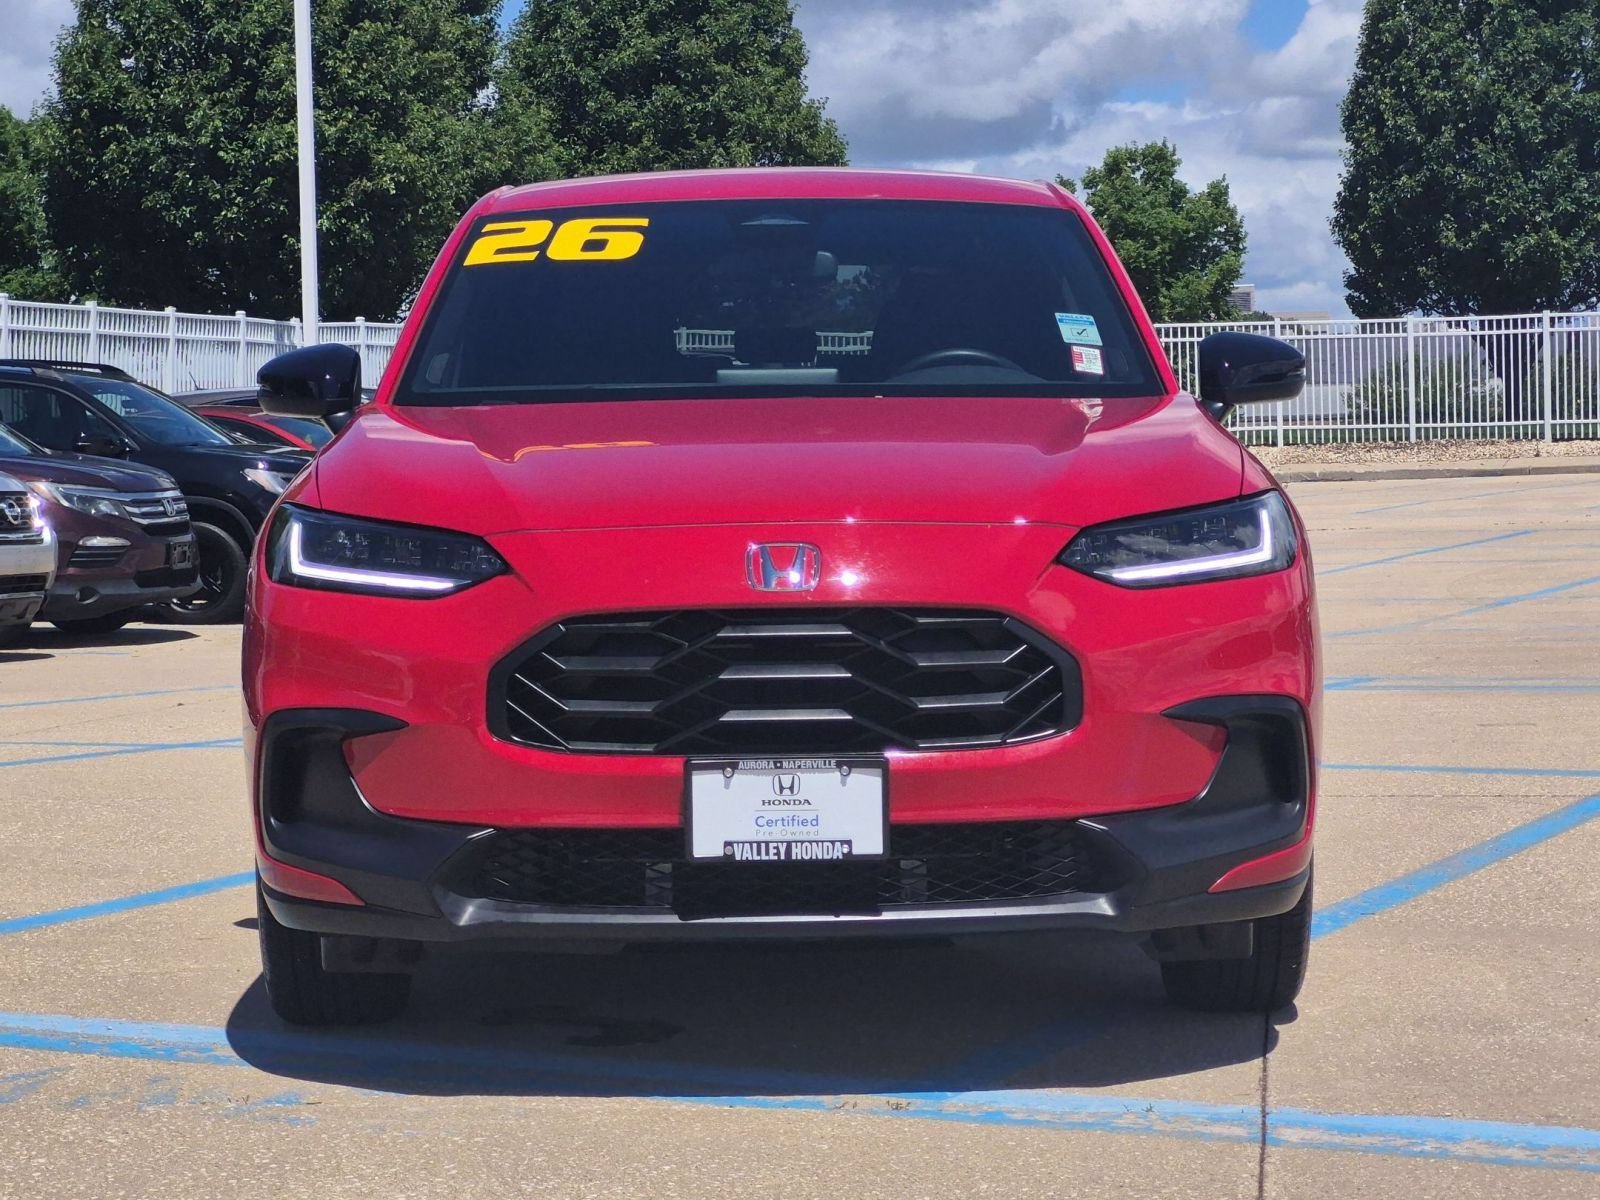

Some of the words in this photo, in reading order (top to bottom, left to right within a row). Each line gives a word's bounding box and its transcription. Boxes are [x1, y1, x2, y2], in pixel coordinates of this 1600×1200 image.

[463, 218, 649, 266] 26
[738, 761, 775, 770] AURORA
[782, 760, 837, 769] NAPERVILLE
[755, 815, 819, 828] Certified
[755, 829, 819, 837] Pre-Owned
[733, 842, 788, 861] VALLEY
[791, 841, 843, 860] HONDA
